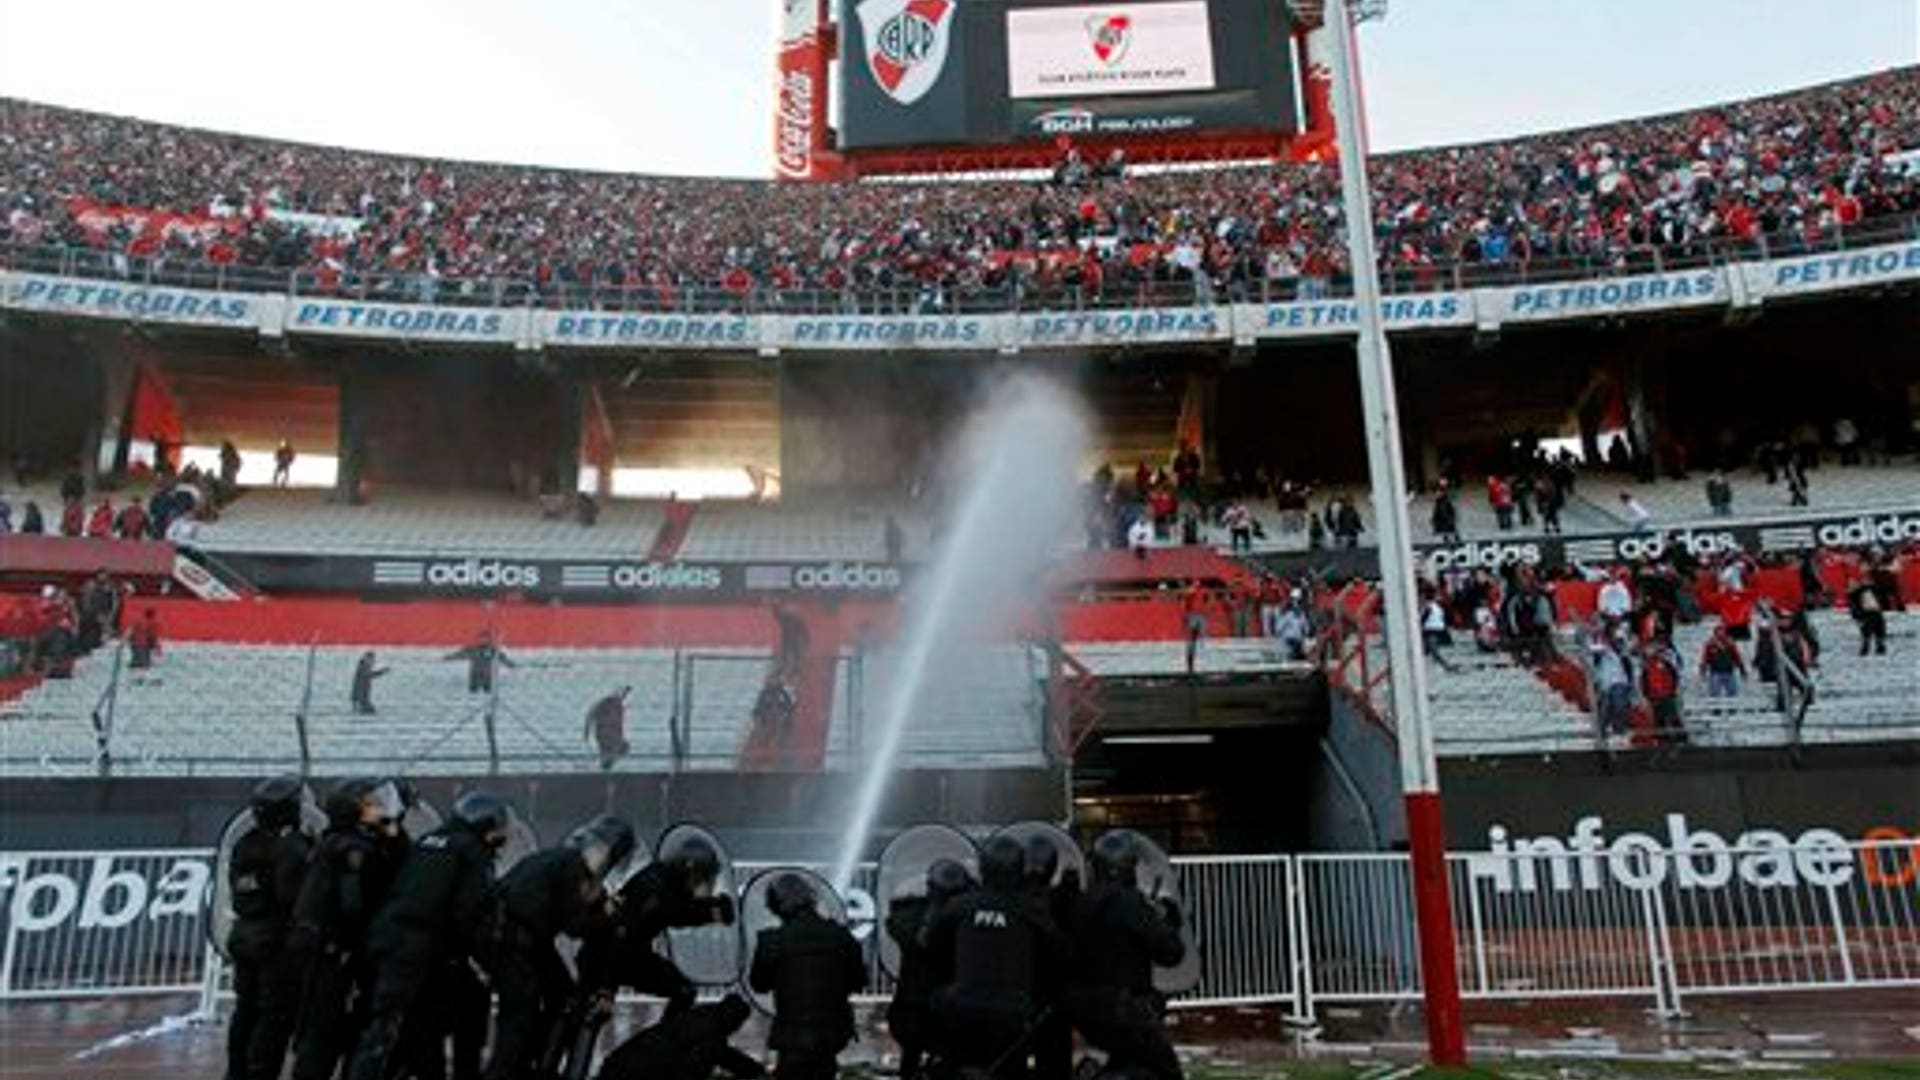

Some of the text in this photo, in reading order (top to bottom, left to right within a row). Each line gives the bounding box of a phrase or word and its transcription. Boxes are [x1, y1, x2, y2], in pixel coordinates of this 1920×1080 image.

[22, 279, 249, 318] PETROBRAS
[1513, 274, 1716, 312] PETROBRAS
[297, 303, 503, 335] PETROBRAS
[1267, 297, 1459, 327] PETRRAS
[556, 316, 747, 341] PETROBRAS
[794, 320, 980, 342] PETROBRAS
[1431, 541, 1541, 570] adidas
[1619, 529, 1739, 559] adas
[428, 562, 900, 588] adidas adidas adidas
